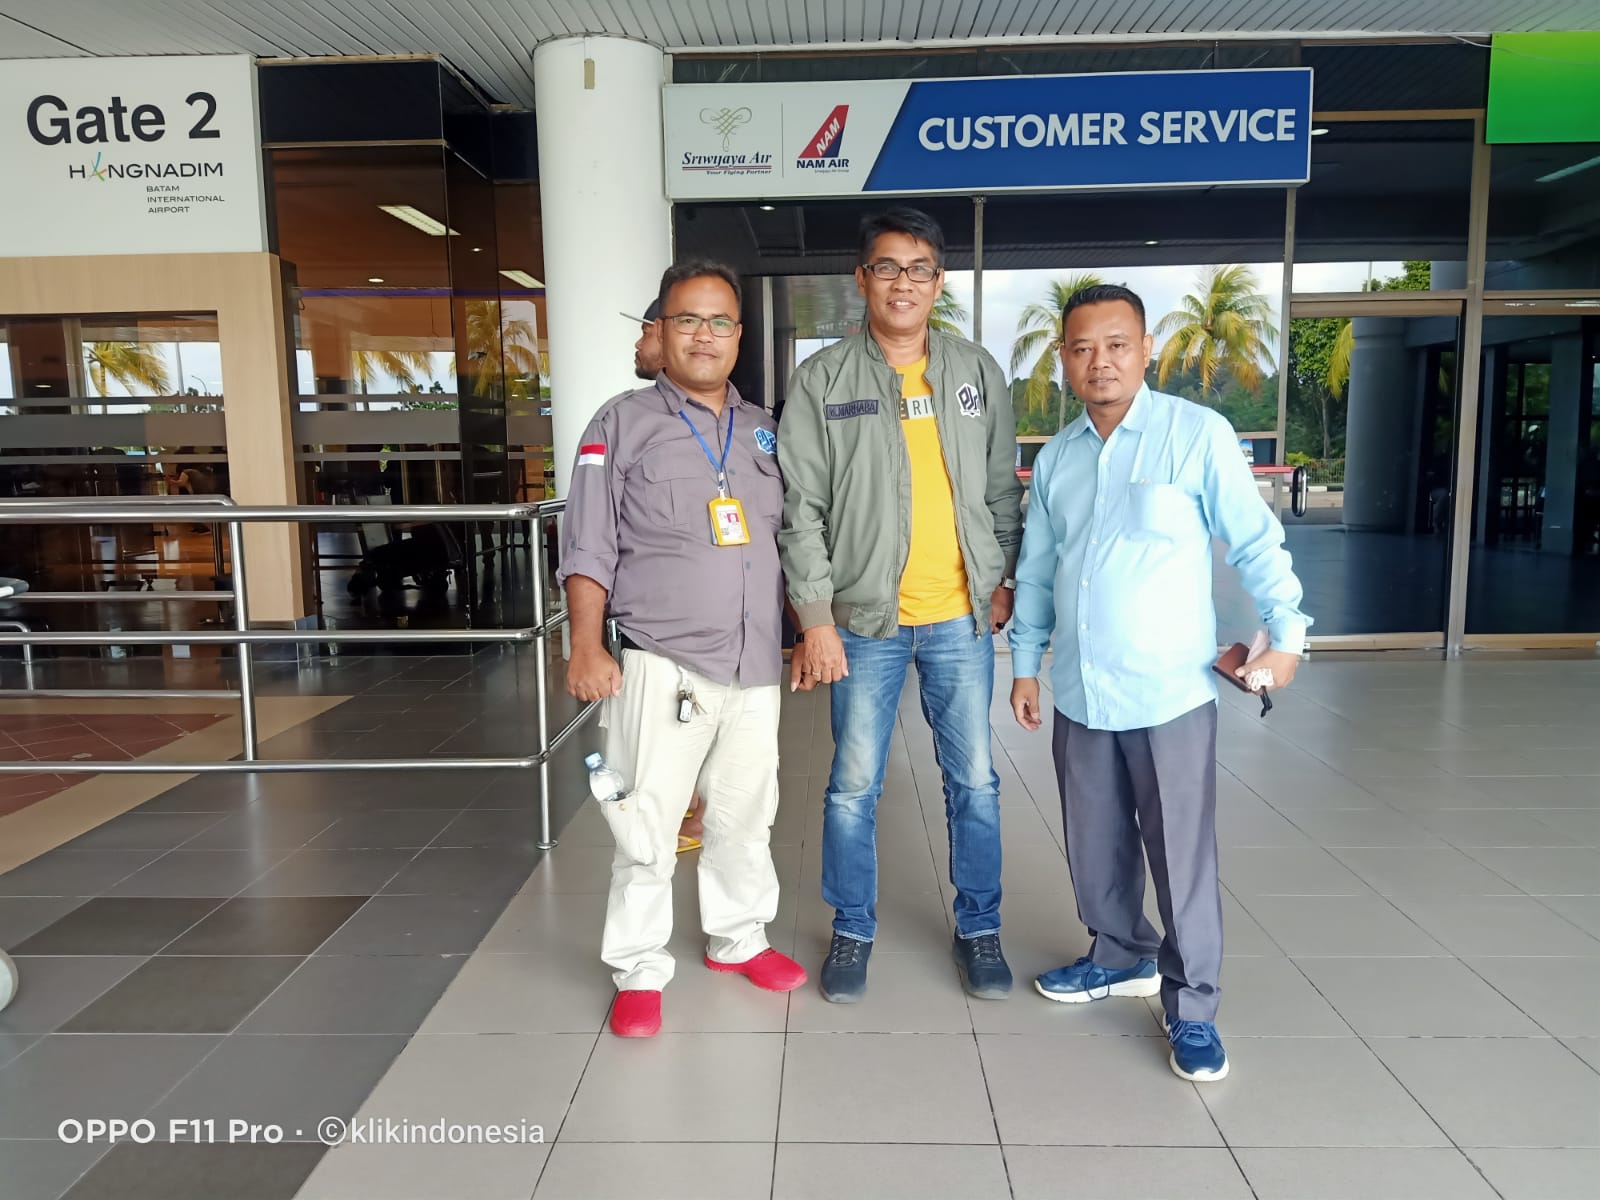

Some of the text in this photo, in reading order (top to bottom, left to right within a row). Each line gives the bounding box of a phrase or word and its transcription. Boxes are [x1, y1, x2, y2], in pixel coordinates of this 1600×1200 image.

[27, 91, 221, 146] Gate 2
[918, 108, 1296, 151] CUSTOMER SERVICE
[815, 117, 841, 156] NAM
[749, 151, 772, 164] Air
[796, 158, 850, 169] NAM AIR
[146, 185, 180, 193] BATAM
[147, 195, 225, 203] INTERNATIONAL
[148, 206, 190, 214] AIRPORT
